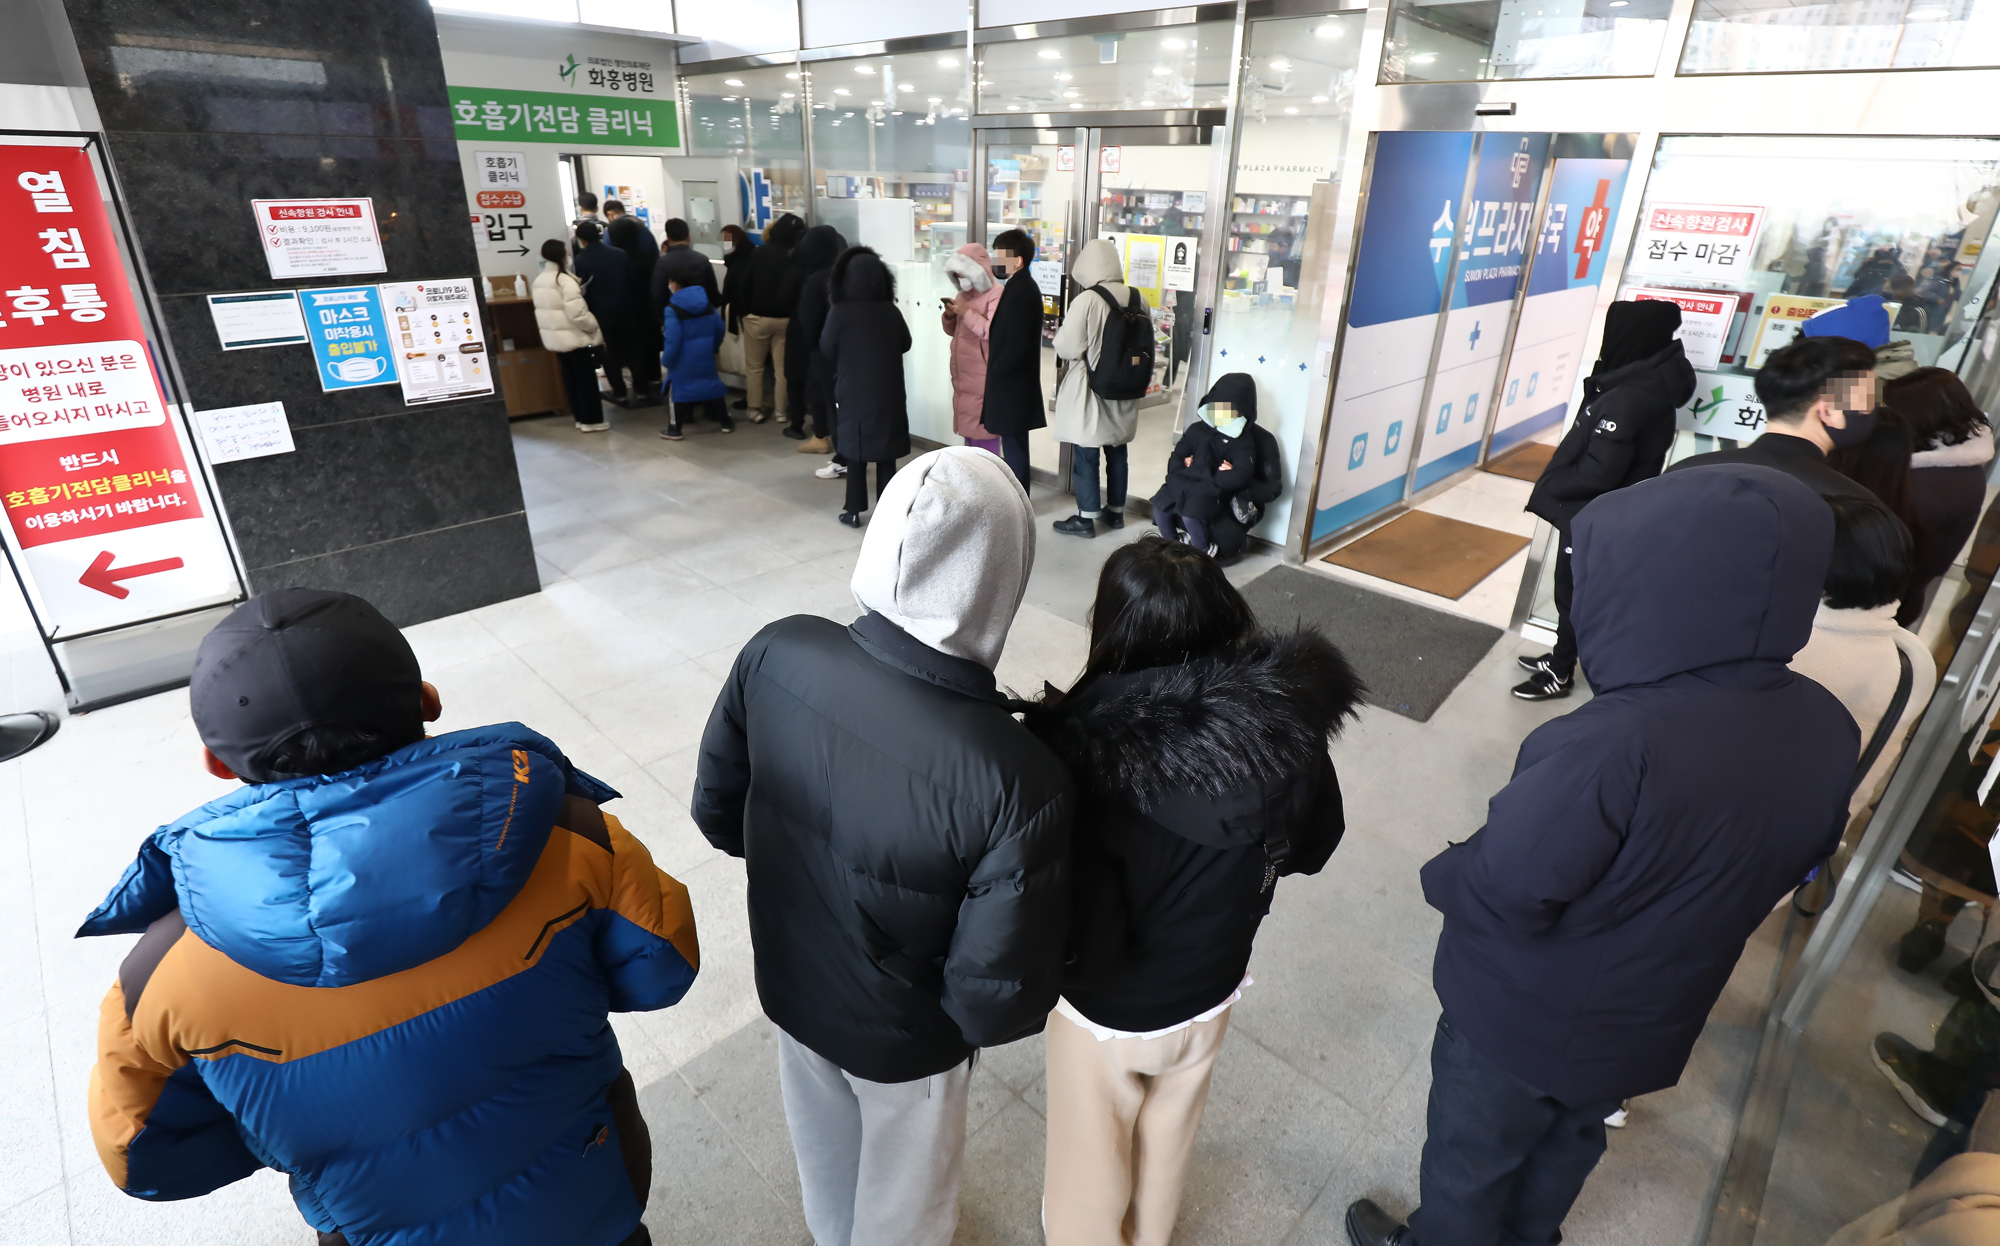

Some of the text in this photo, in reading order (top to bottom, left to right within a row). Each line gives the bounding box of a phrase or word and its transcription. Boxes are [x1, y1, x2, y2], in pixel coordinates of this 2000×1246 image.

[588, 68, 654, 92] 화홍병원
[455, 100, 653, 137] 호흡기전담 클리닉
[485, 157, 517, 169] 호흡기
[1243, 164, 1271, 172] PLAZA
[1274, 165, 1325, 173] PHARMACY
[488, 171, 519, 183] 클리닉
[17, 170, 74, 213] 열
[316, 207, 334, 217] 검사
[336, 207, 354, 217] 안내
[485, 213, 533, 241] 입구
[1582, 208, 1603, 259] 약
[1655, 213, 1748, 234] 신속항원검사
[38, 227, 91, 269] 침
[1647, 239, 1741, 266] 접수 마감
[1483, 267, 1498, 280] PLAZA
[319, 306, 371, 325] 마스크
[1697, 302, 1715, 312] 안내
[324, 324, 374, 340] 미착용시
[328, 340, 378, 357] 출입불가
[35, 356, 96, 378] 있으신
[100, 354, 138, 372] 분은
[21, 381, 108, 403] 병원 내로
[96, 401, 151, 419] 마시고
[59, 449, 120, 472] 반드시
[5, 469, 188, 509] 호흡기전담클리닉을
[25, 493, 188, 530] 이용하시기 바랍니다.
[511, 749, 530, 785] K2
